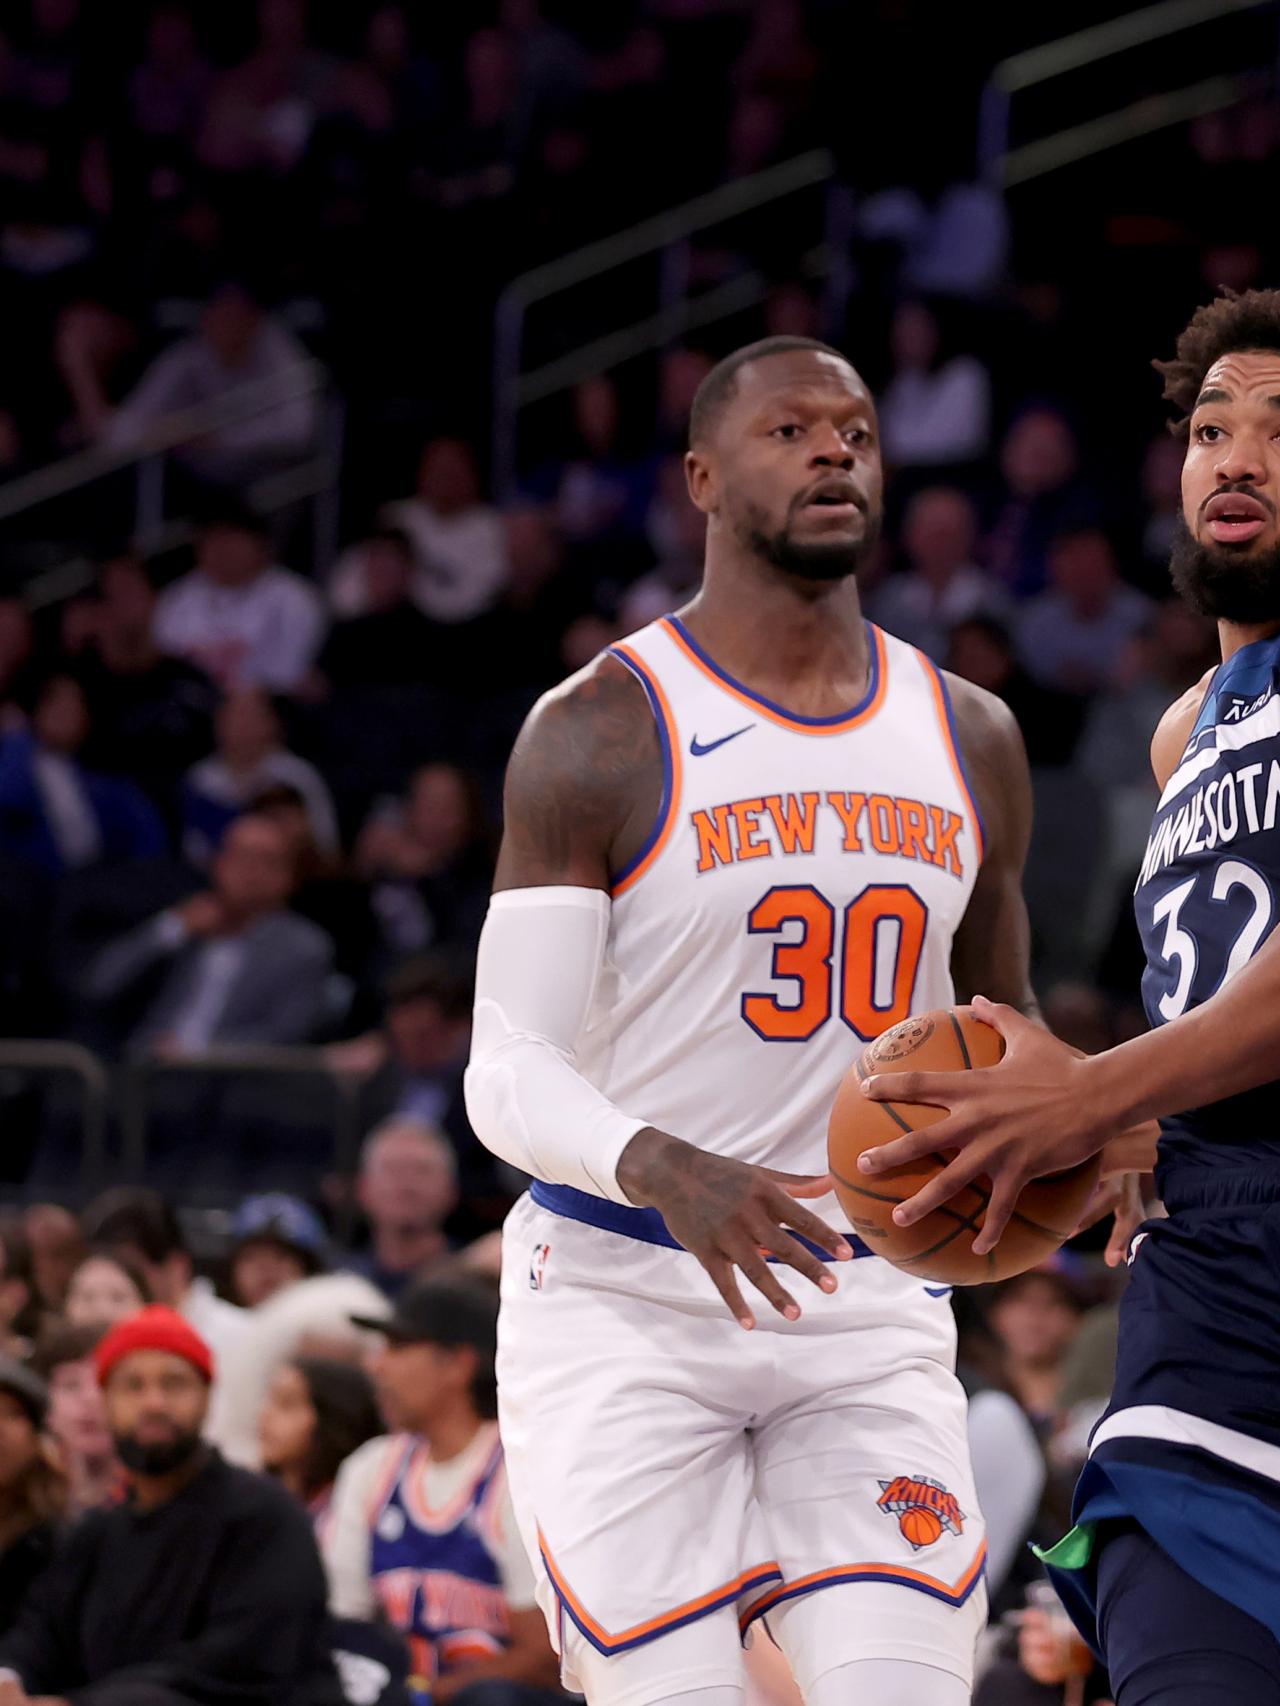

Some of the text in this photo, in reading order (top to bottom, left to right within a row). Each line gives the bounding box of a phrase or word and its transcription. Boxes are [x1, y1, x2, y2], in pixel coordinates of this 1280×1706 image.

[690, 791, 963, 881] NEW YORK
[740, 883, 929, 1042] 30
[1151, 857, 1274, 1021] 32
[876, 1475, 964, 1535] KNICKS
